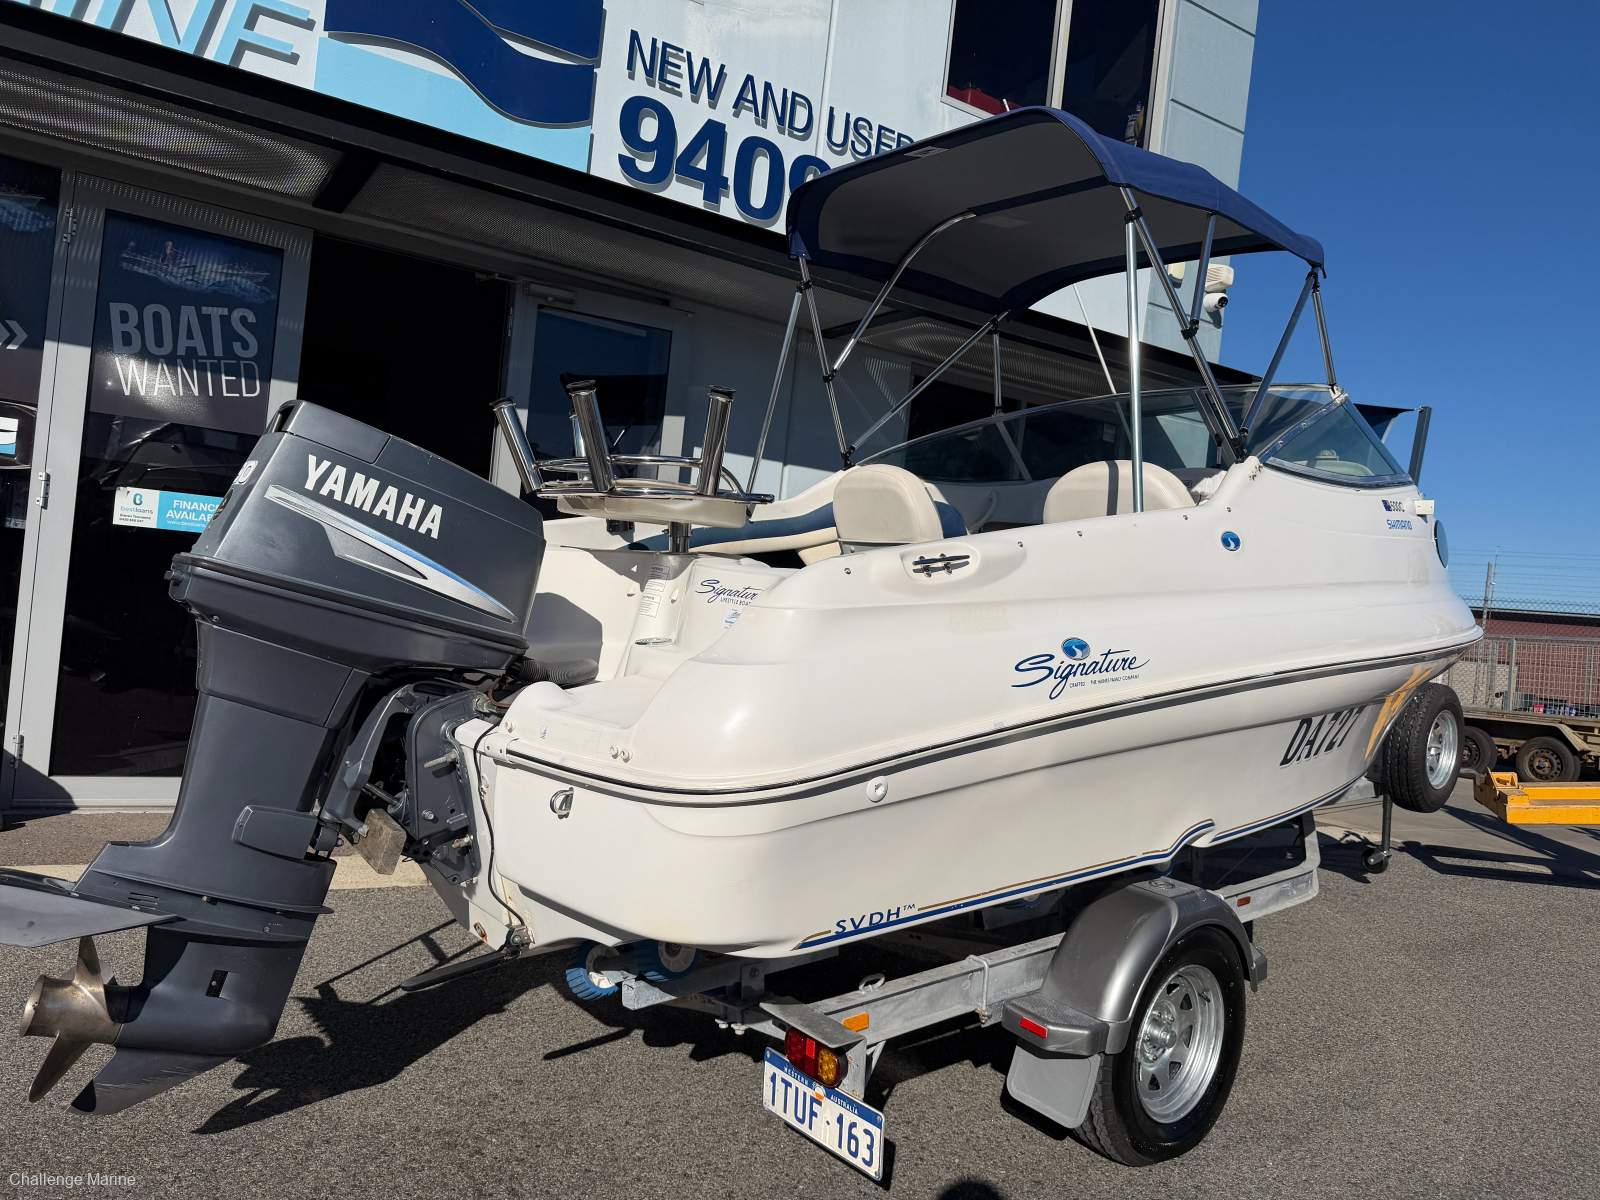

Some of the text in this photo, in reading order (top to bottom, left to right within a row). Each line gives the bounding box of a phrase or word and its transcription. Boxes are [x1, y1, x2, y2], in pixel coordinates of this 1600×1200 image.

[626, 29, 726, 101] NEW
[732, 73, 814, 134] AND
[109, 302, 259, 358] BOATS
[114, 356, 261, 398] WANTED
[304, 454, 443, 540] YAMAHA
[1011, 649, 1150, 700] Signature
[1279, 704, 1367, 767] DA727
[784, 1065, 858, 1115] WESTERN AUSTRALIA
